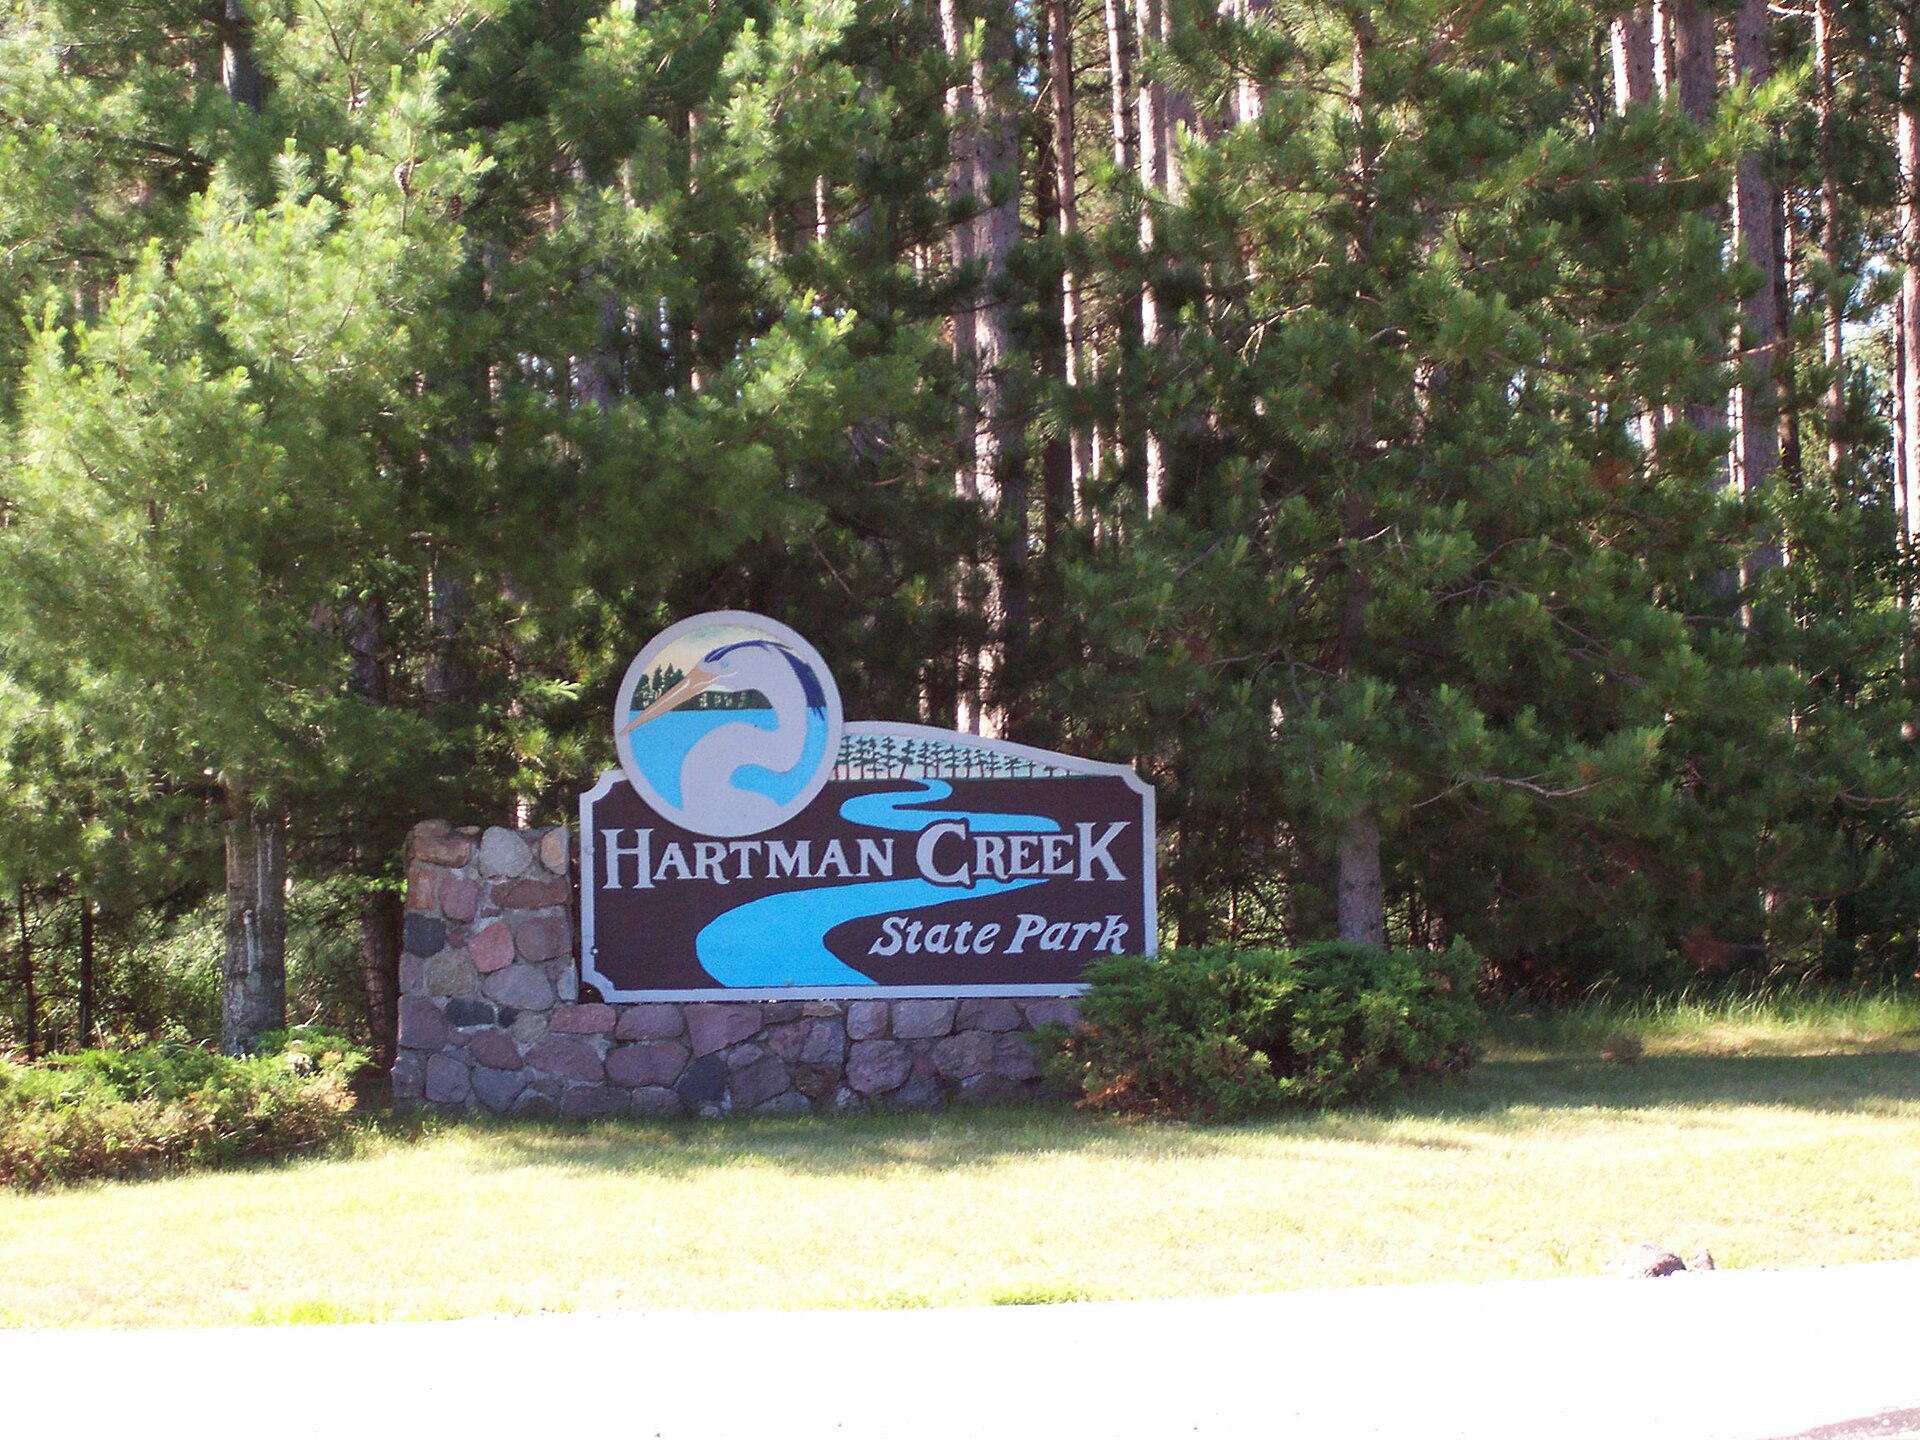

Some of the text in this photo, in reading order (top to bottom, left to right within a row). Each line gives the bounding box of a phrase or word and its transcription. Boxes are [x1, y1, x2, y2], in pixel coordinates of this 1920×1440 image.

[600, 820, 1132, 889] HARTMAN CREEK
[868, 913, 1130, 957] State Park
